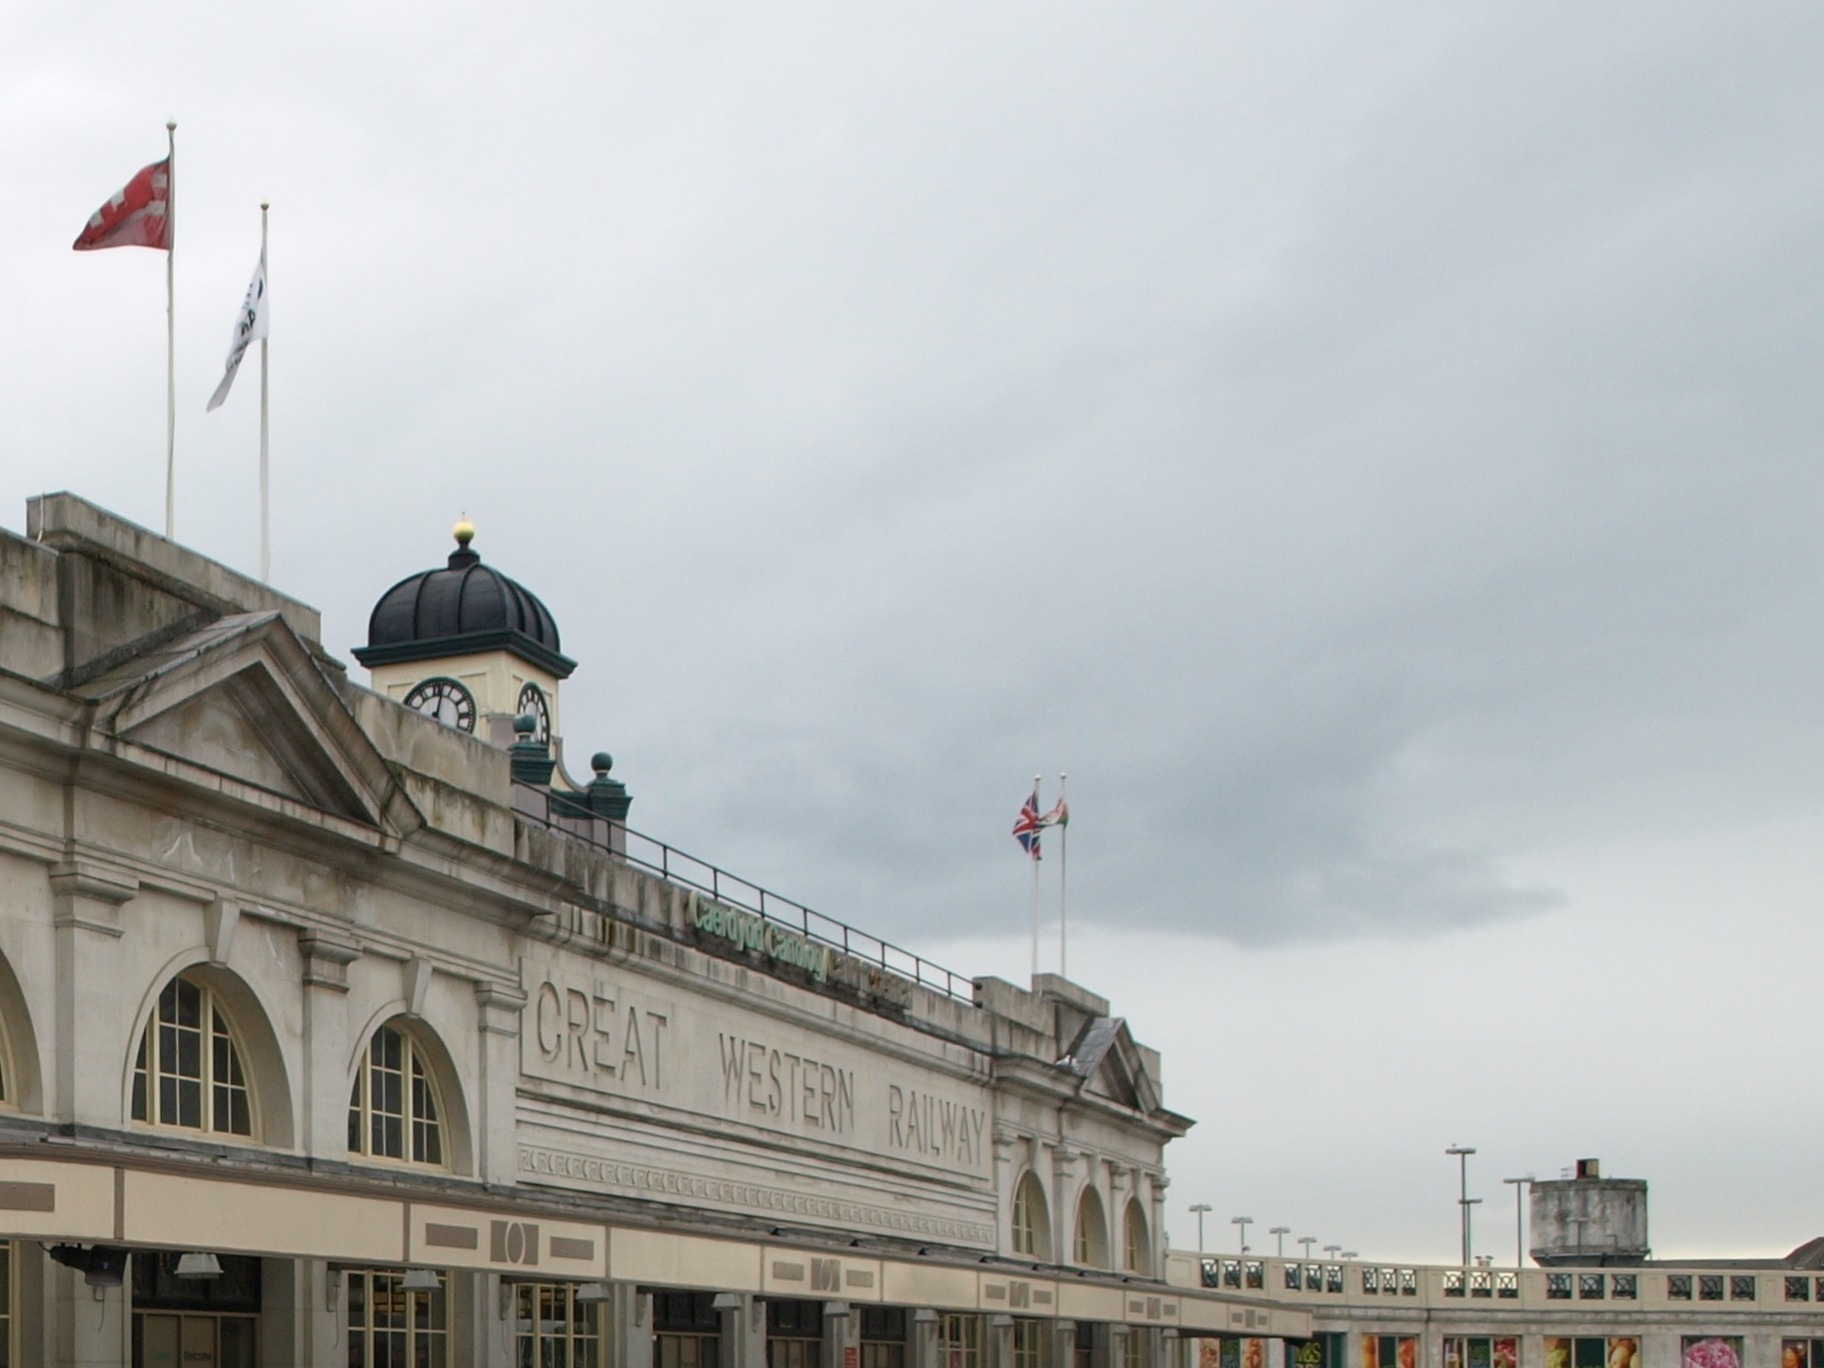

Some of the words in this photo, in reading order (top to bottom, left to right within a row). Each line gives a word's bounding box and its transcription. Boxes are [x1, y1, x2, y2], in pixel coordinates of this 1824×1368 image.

[687, 890, 765, 953] Caerdydd
[764, 921, 830, 984] Canolog
[537, 981, 668, 1091] GREAT
[719, 1032, 855, 1135] WESTERN
[888, 1083, 987, 1167] RAILWAY
[1295, 1342, 1322, 1364] M&S
